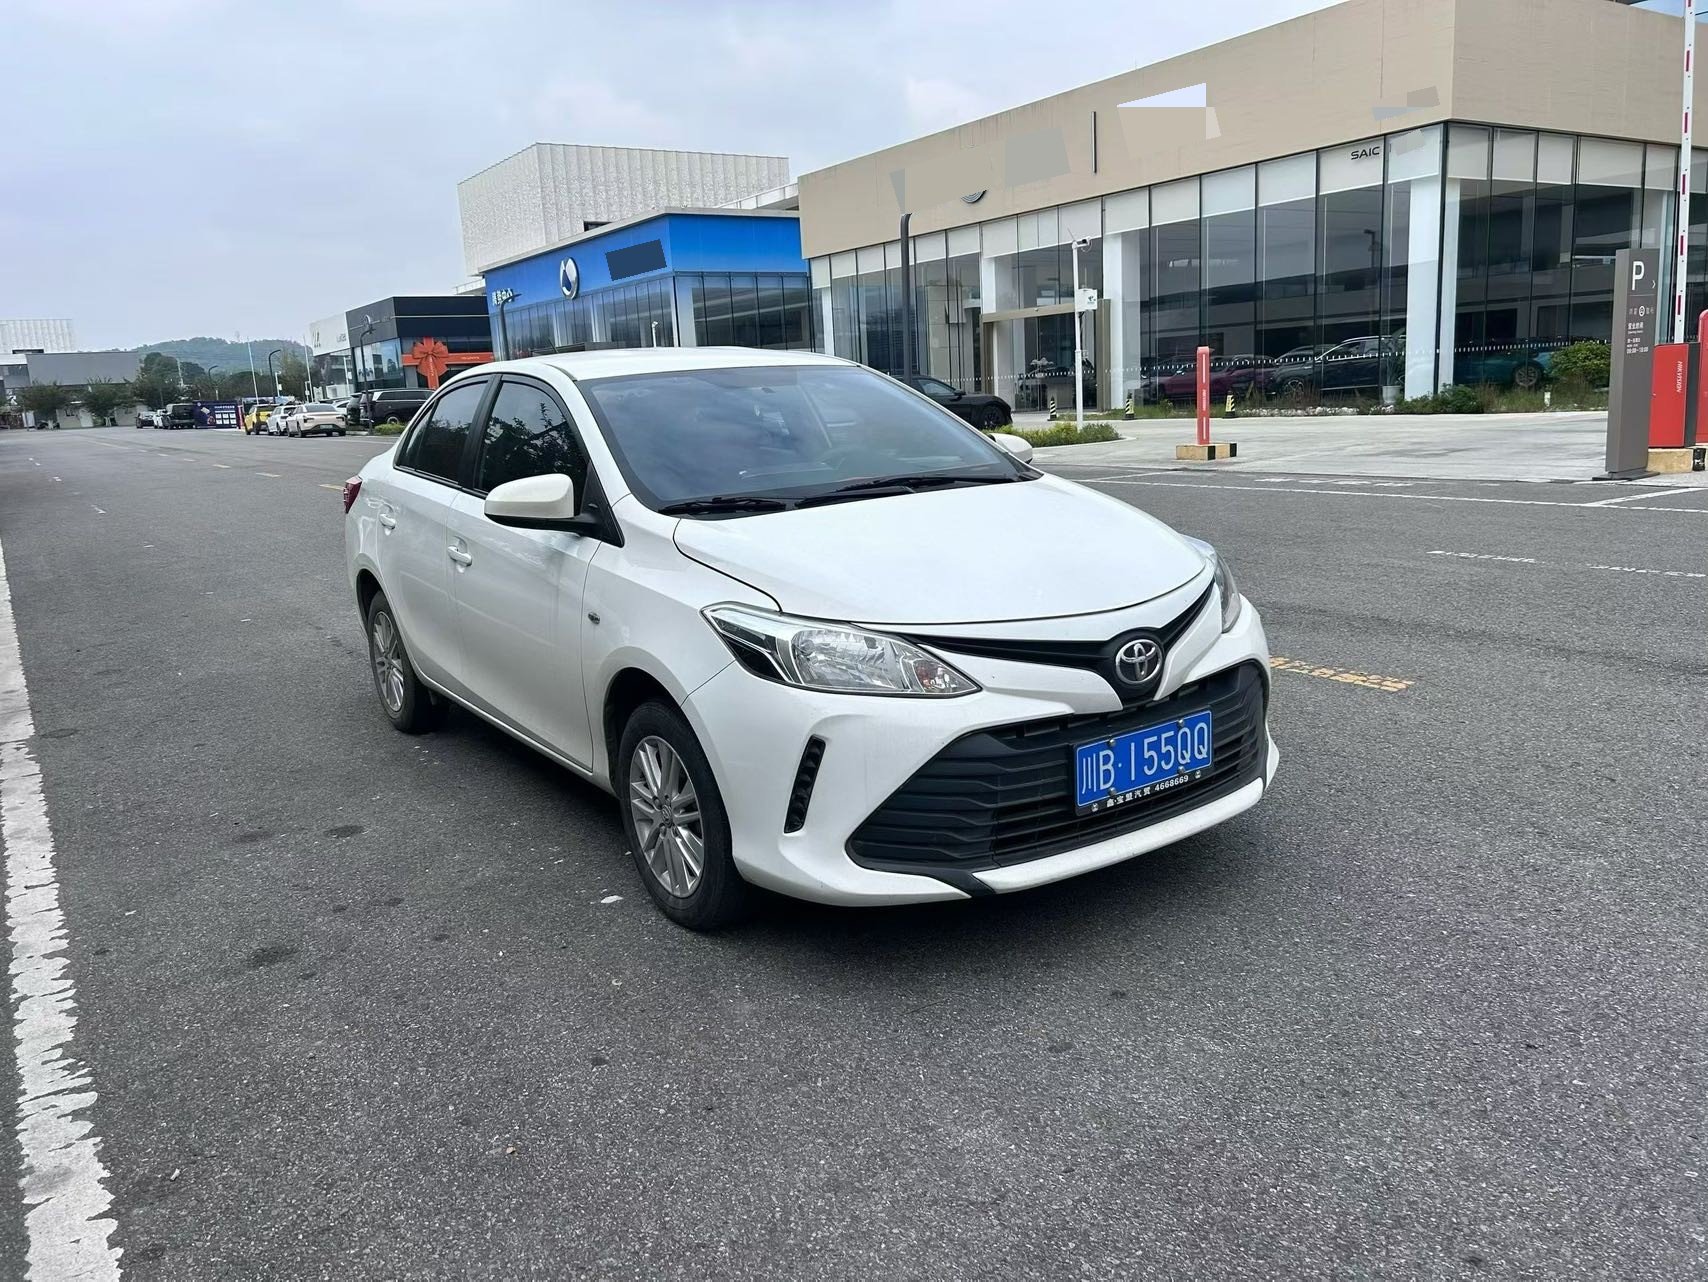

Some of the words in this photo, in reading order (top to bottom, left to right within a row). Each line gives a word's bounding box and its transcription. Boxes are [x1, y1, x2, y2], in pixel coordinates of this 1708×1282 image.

[1351, 146, 1380, 160] SAIC
[1631, 261, 1645, 291] P
[1154, 775, 1189, 791] 4668669
